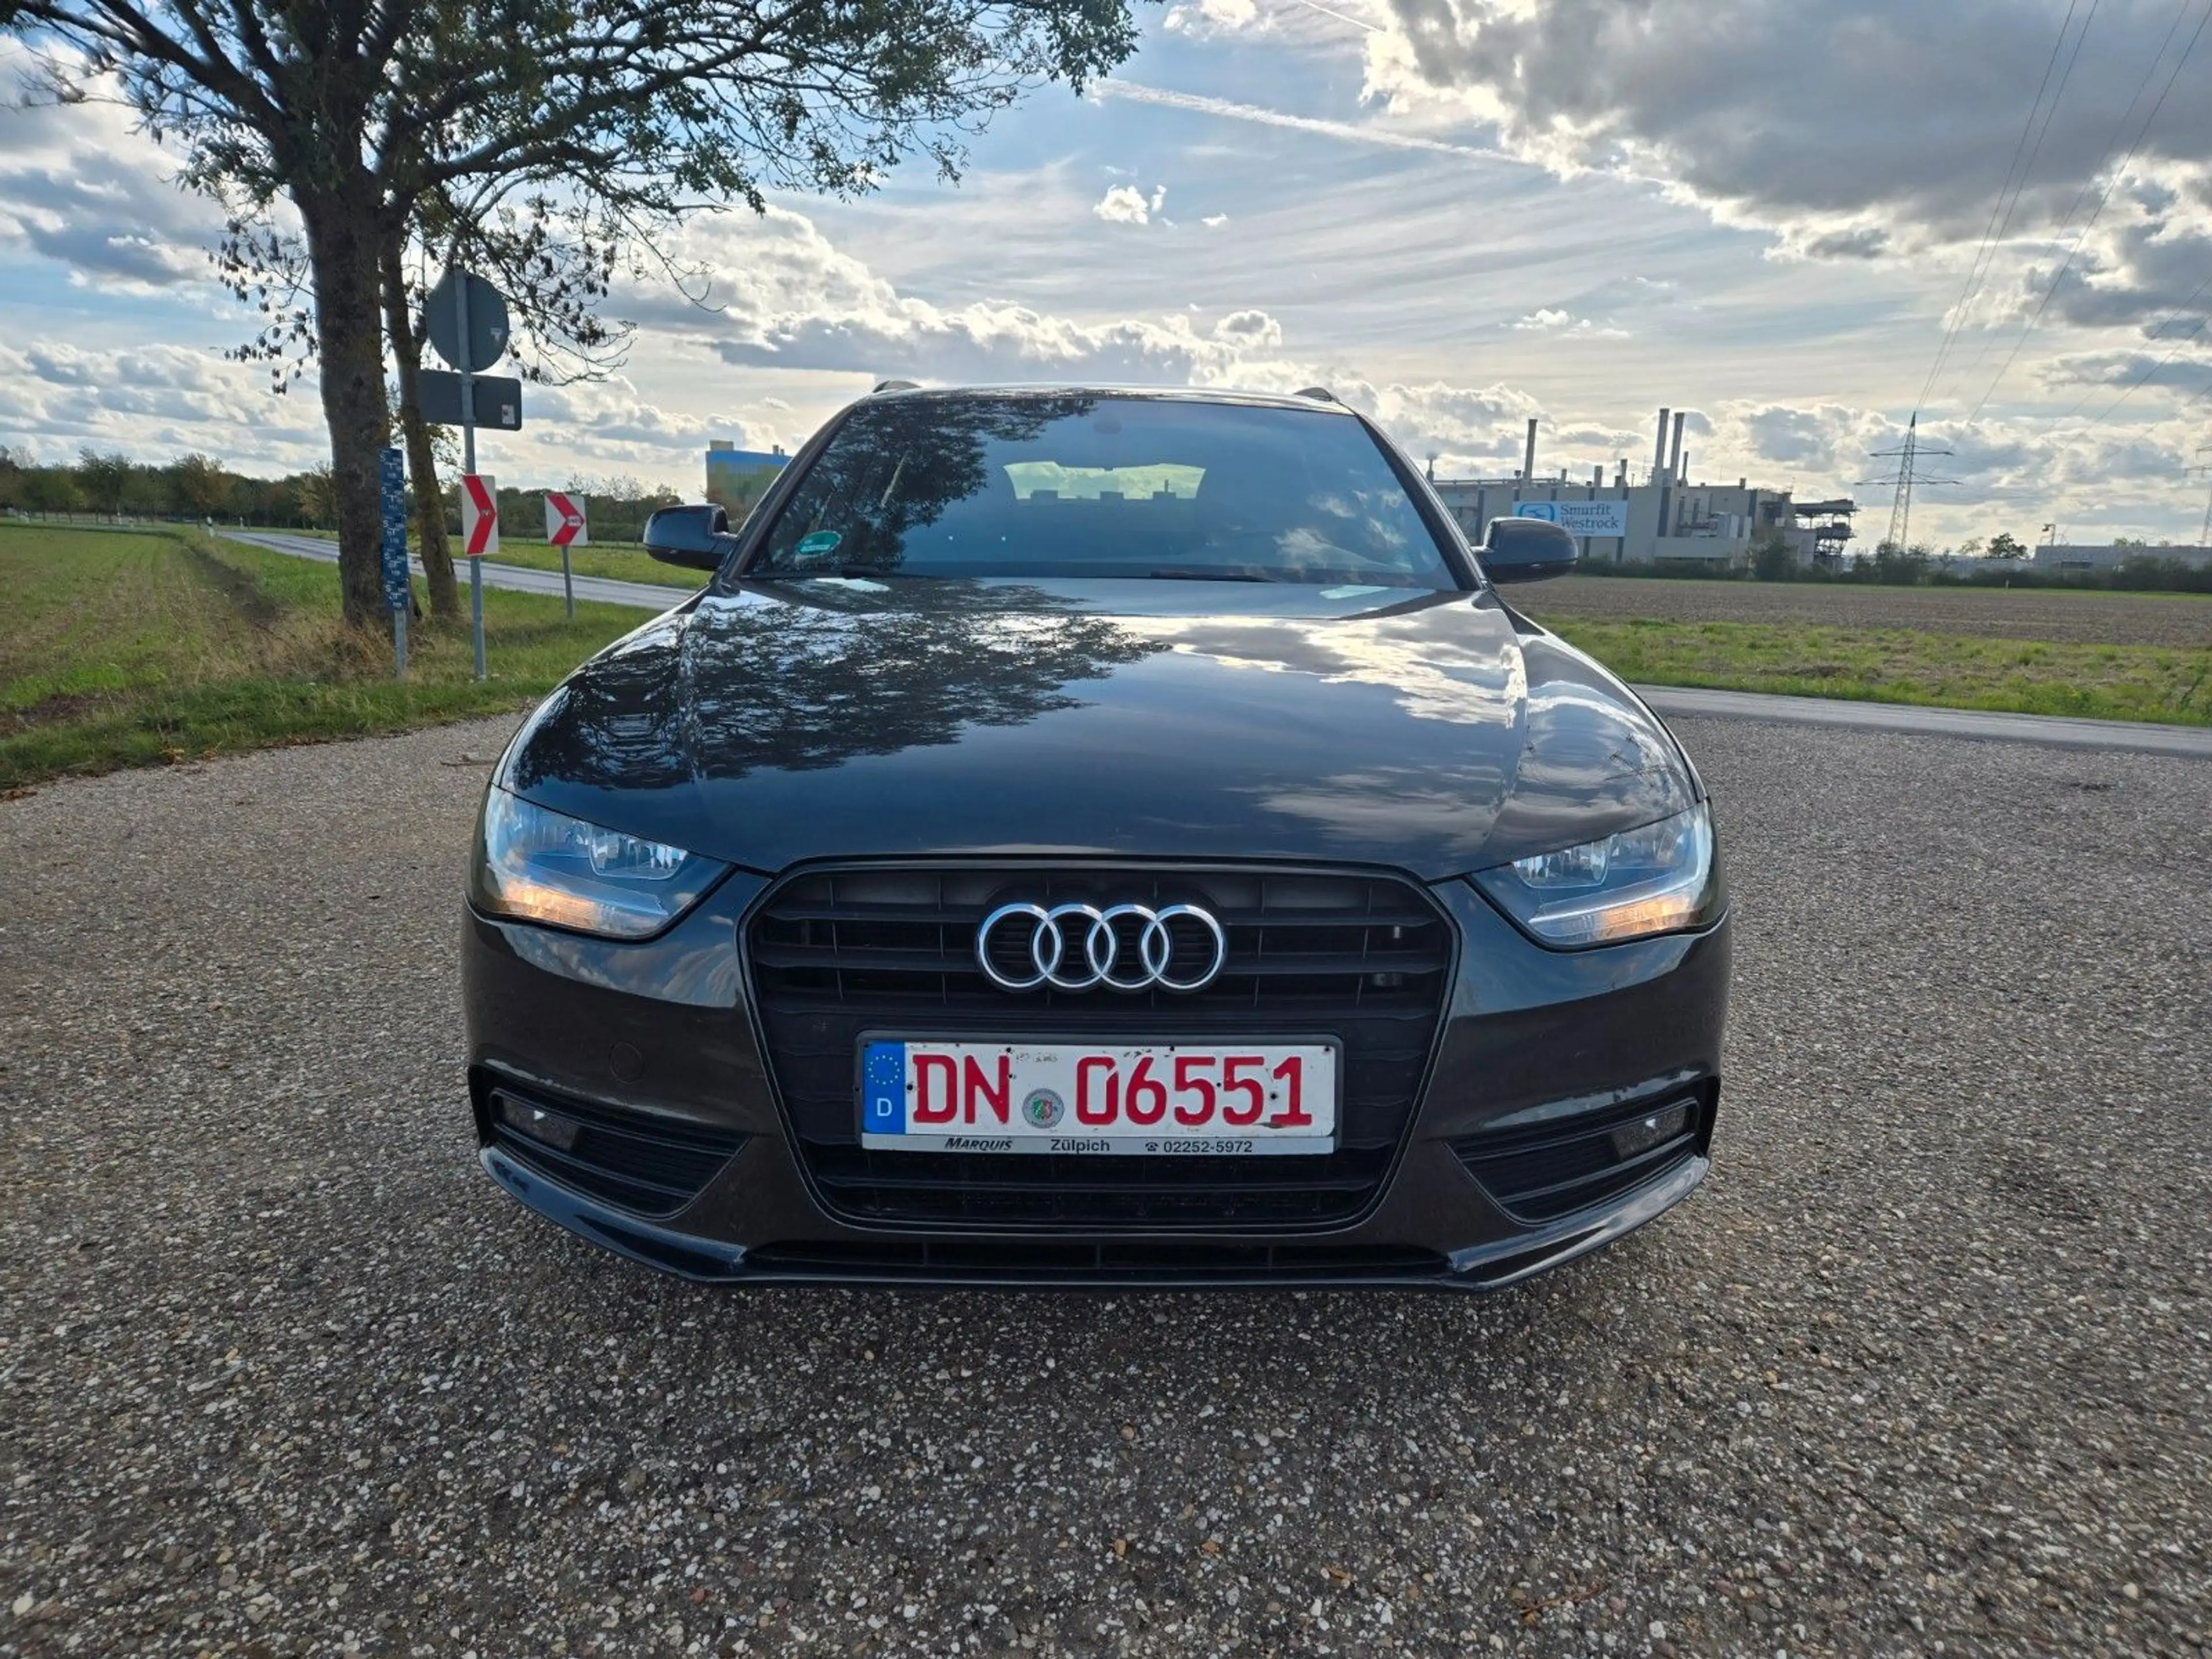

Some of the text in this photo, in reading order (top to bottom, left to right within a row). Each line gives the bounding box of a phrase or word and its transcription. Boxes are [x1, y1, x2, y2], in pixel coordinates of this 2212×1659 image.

[1560, 503, 1611, 516] Smurfit
[1560, 516, 1619, 529] Westrock
[912, 1054, 1010, 1124] DN
[1076, 1056, 1312, 1127] 06551
[876, 1097, 892, 1116] D
[1051, 1139, 1110, 1154] Zülpich
[1163, 1141, 1252, 1153] 02252-5972
